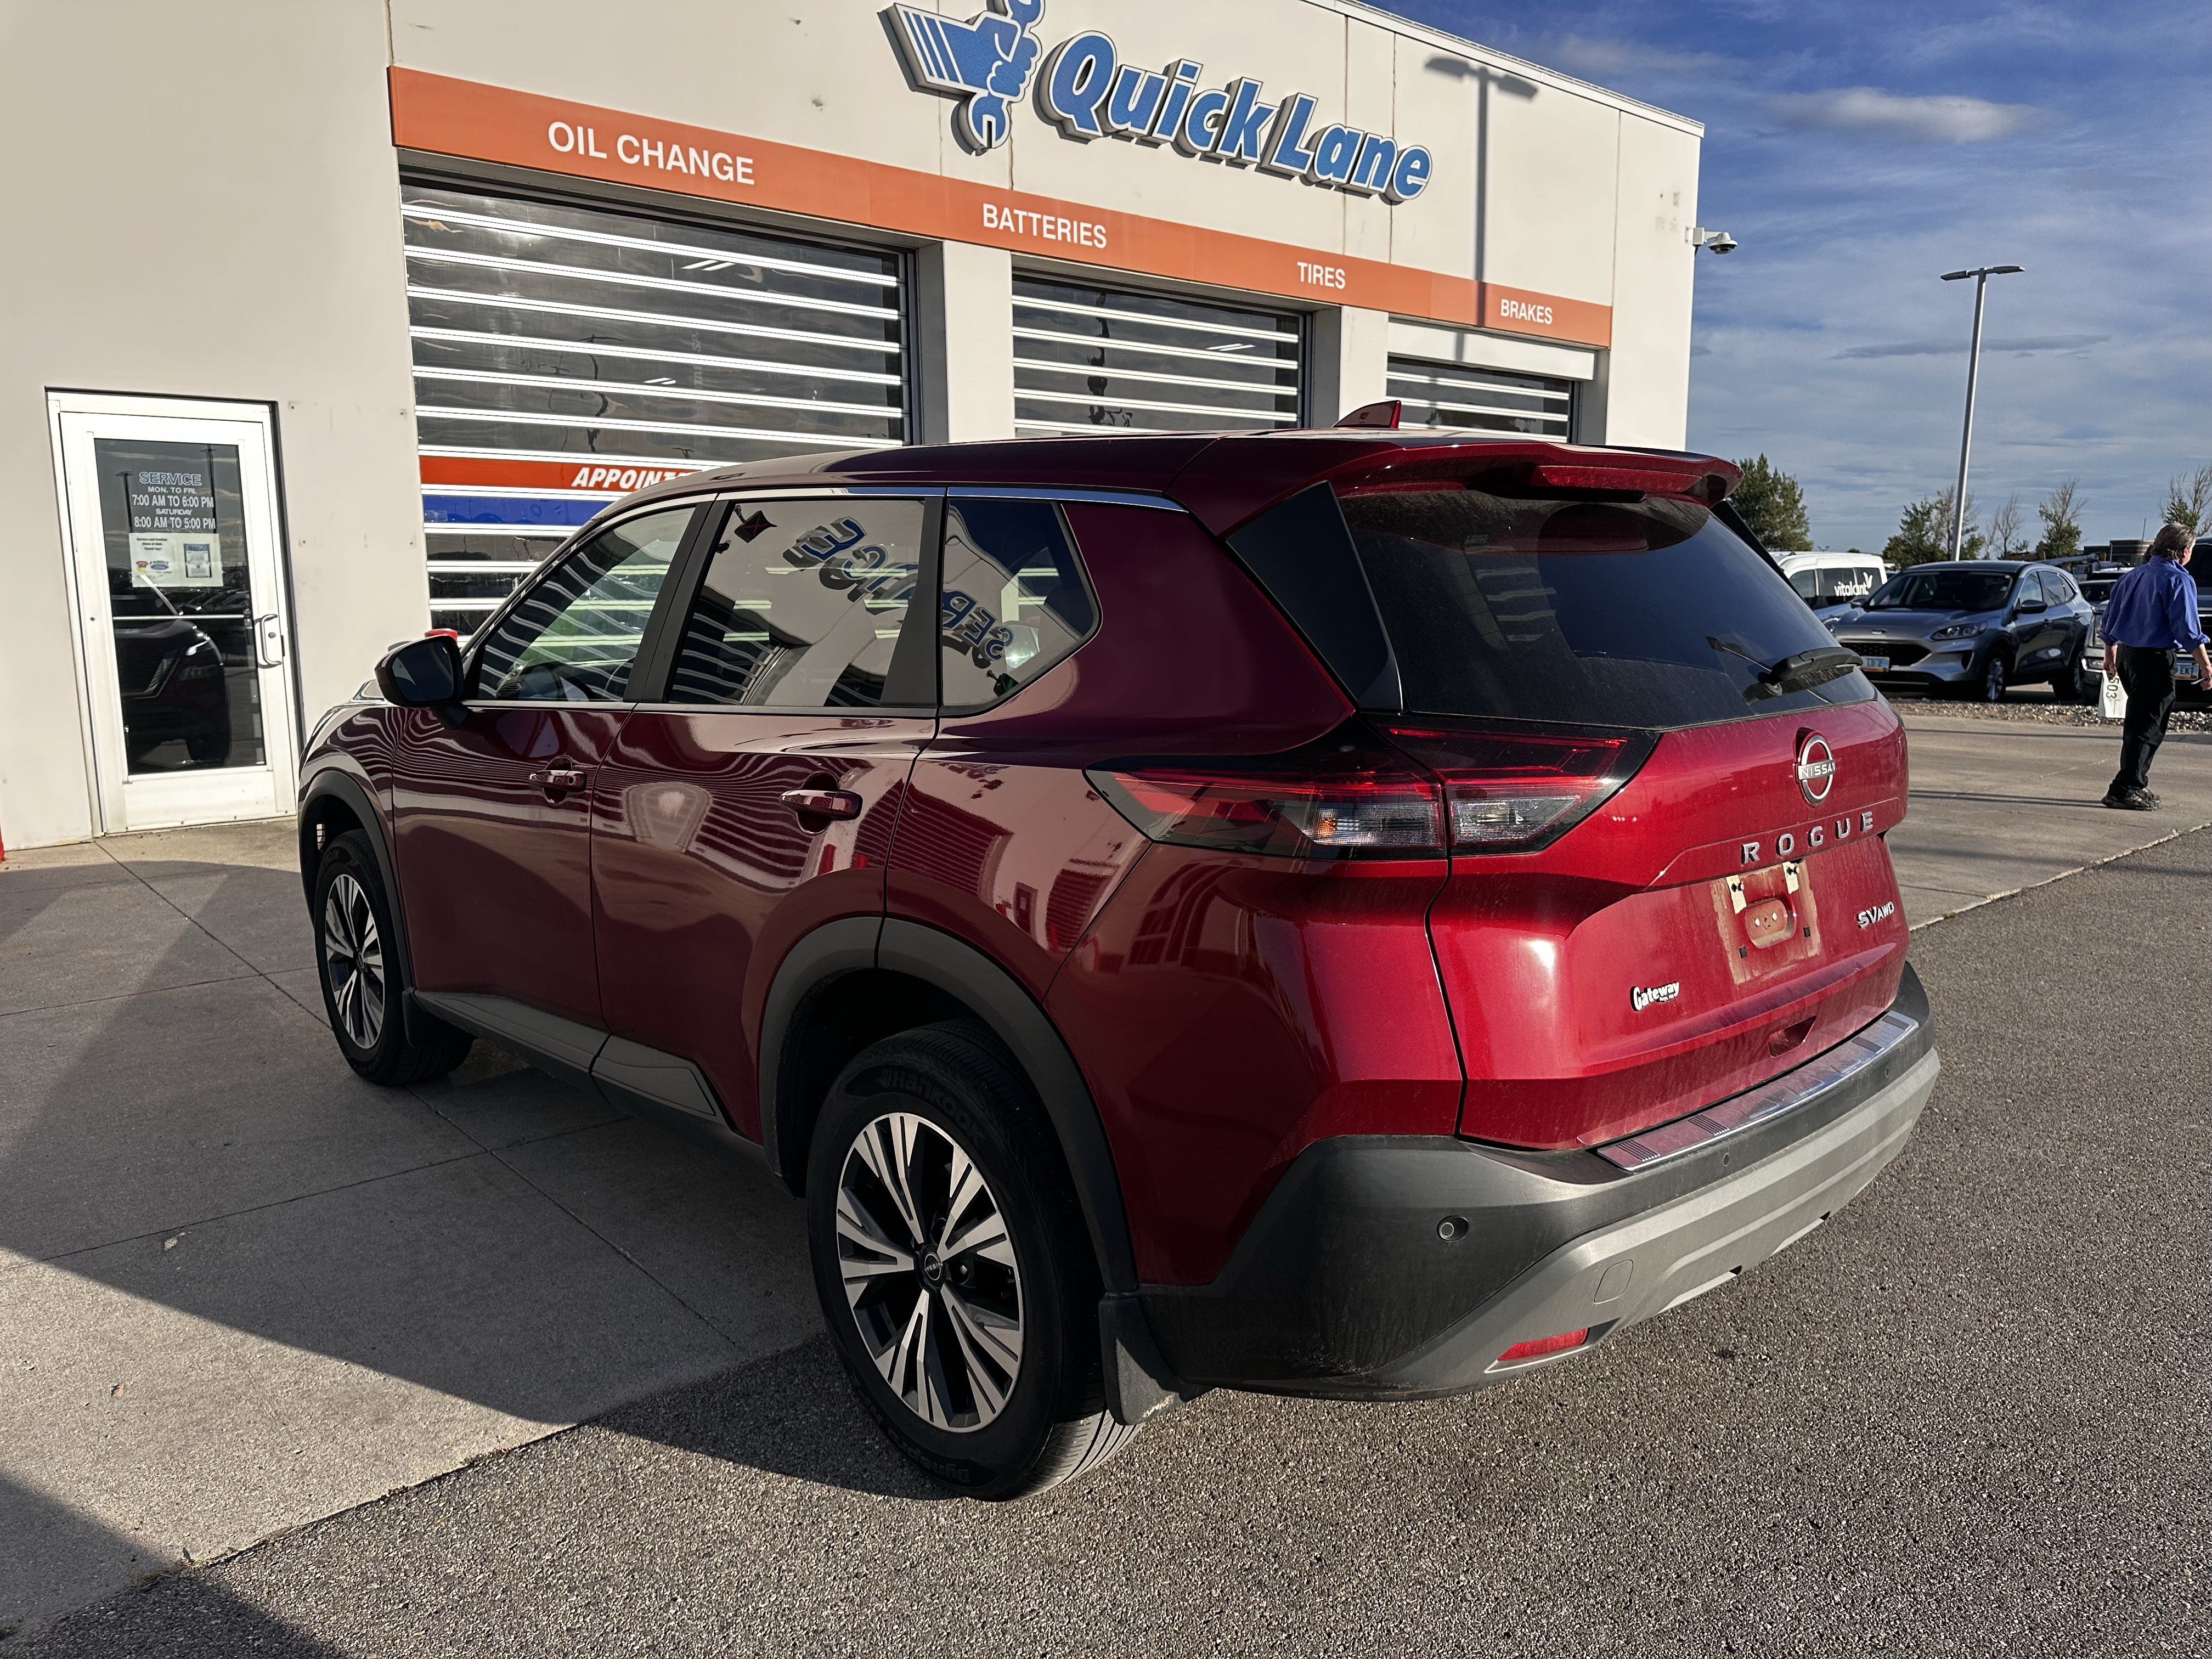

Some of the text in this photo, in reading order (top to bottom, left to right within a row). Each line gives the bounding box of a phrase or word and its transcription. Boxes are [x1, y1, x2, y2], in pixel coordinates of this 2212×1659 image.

[1042, 30, 1433, 204] Quick Lane
[548, 121, 755, 185] OIL CHANGE
[983, 203, 1107, 249] BATTERIES
[1297, 262, 1346, 290] TIRES
[1500, 298, 1553, 325] BRAKES
[139, 472, 202, 486] SERVICE
[132, 494, 214, 508] 7:00 AM TO 6:00 PM
[134, 516, 216, 529] 8:00 AM TO 5:00 PM
[1800, 761, 1836, 778] NISSAN
[1741, 811, 1874, 864] ROGUE
[1632, 981, 1679, 1011] Gateway
